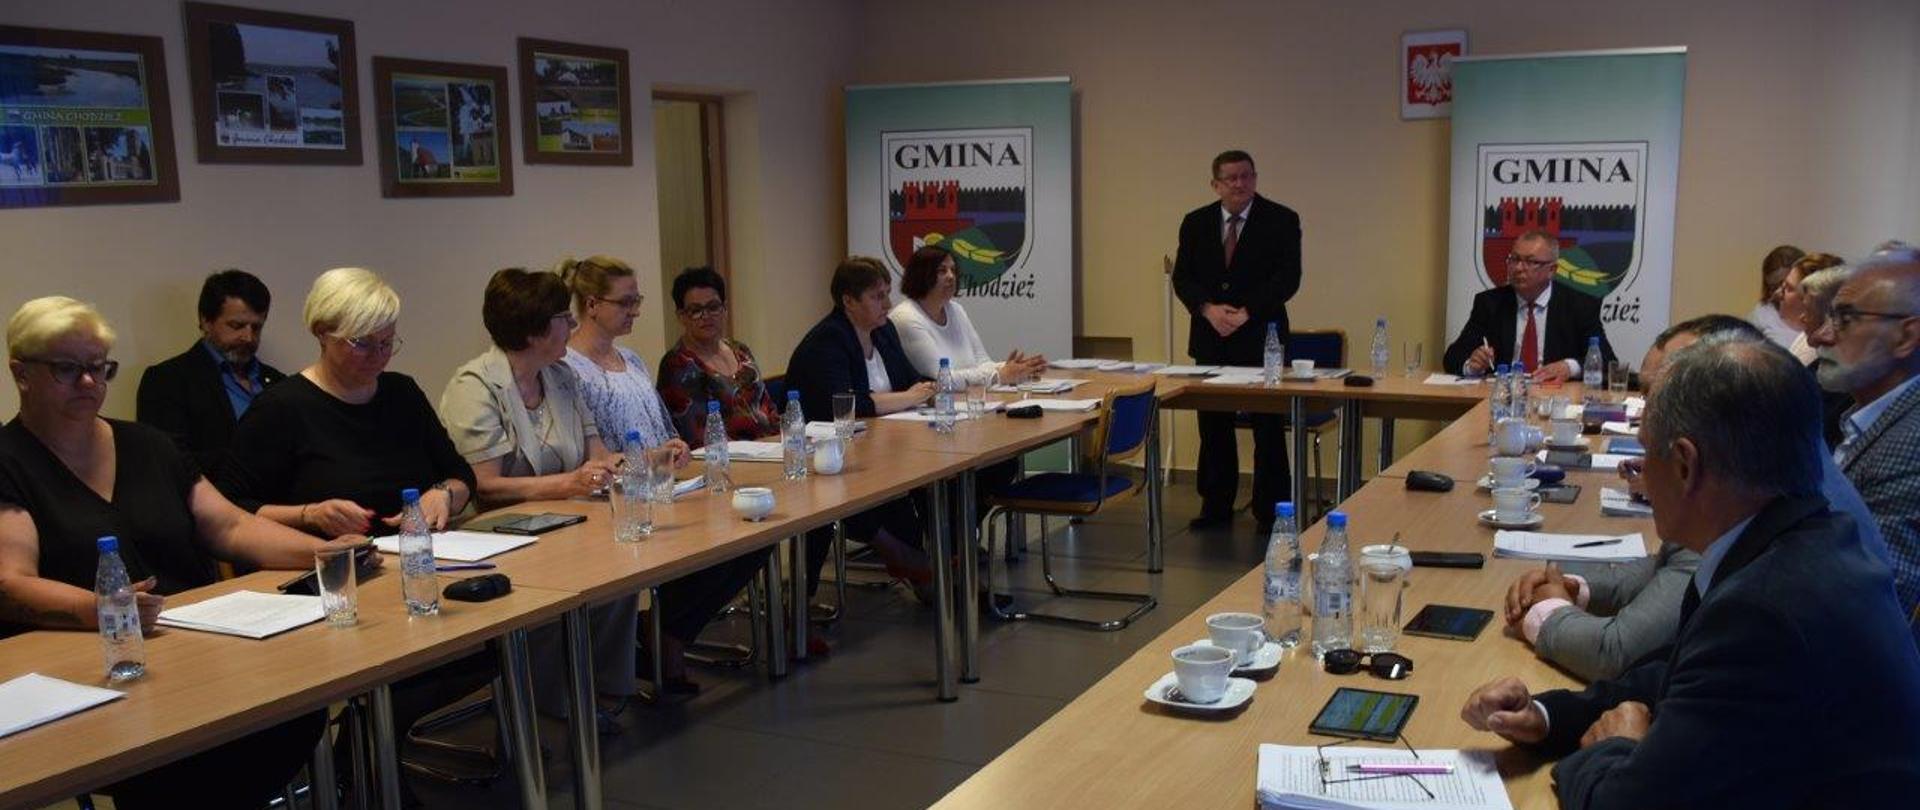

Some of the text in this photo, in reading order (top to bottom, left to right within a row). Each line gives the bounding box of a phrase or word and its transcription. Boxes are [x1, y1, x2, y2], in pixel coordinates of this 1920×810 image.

[895, 143, 1021, 169] GMINA
[1493, 158, 1632, 184] GMINA
[1602, 296, 1639, 324] zież
